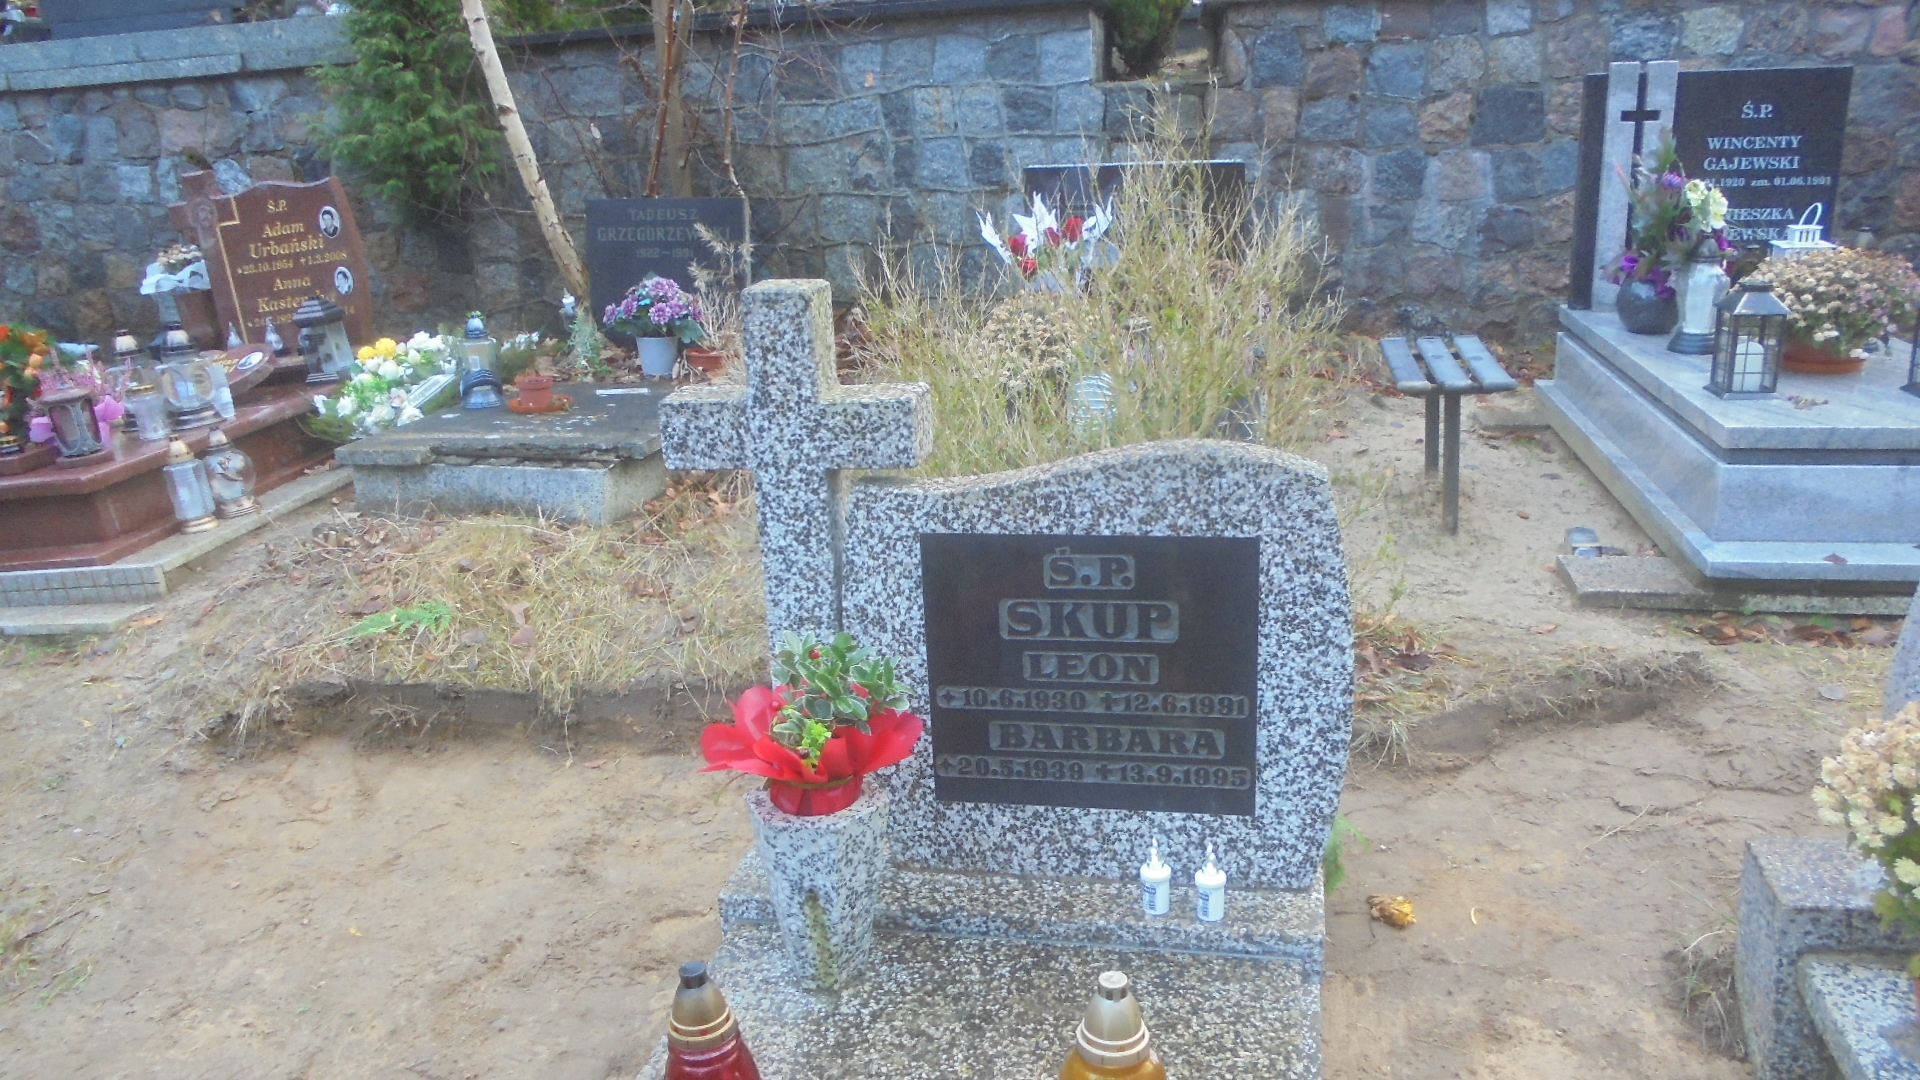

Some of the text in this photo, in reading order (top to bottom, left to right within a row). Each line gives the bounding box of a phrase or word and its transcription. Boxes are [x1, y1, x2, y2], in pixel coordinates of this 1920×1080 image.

[1707, 136, 1802, 149] WINCENTY
[1703, 156, 1800, 170] GAJEWSKI
[628, 208, 700, 220] TADEUSZ
[262, 221, 305, 238] Adam
[597, 226, 732, 241] GRZEGORZEWKI
[249, 234, 325, 258] Urbański
[273, 277, 311, 291] Anna
[1004, 601, 1175, 641] SKUP
[1027, 654, 1156, 683] LEON
[1123, 693, 1247, 717] 12.6.1991
[999, 723, 1224, 756] BARBARA
[957, 755, 1248, 788] 20.5.1939 13.9.1995
